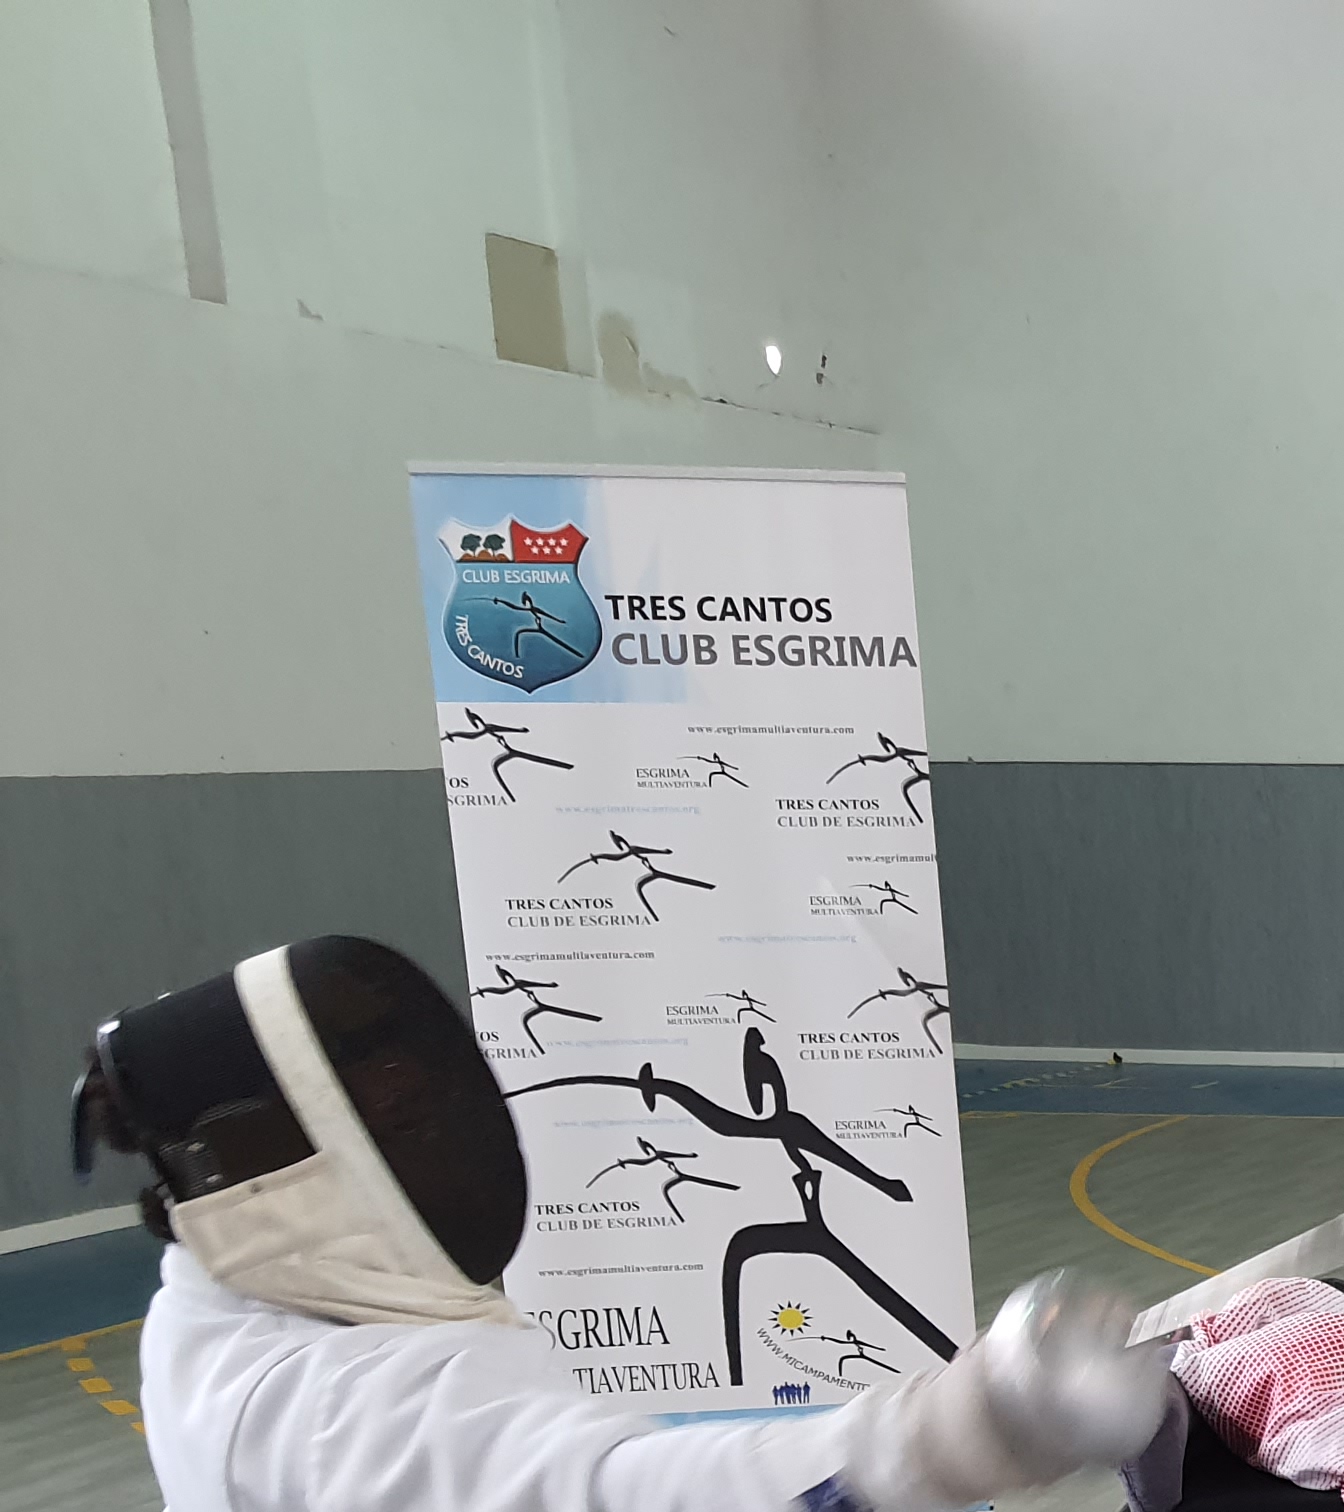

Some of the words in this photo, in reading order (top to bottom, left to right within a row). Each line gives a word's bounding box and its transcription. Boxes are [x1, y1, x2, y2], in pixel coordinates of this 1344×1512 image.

[462, 569, 500, 583] CLUB
[504, 569, 571, 584] ESGRIMA
[604, 594, 686, 621] TRES
[696, 596, 833, 624] CANTOS
[455, 615, 473, 647] TRES
[467, 645, 525, 679] CANTOS
[611, 632, 718, 666] CLUB
[732, 635, 918, 668] ESGRIMA
[636, 768, 690, 779] ESGRIMA
[637, 781, 708, 789] MULTIAVENTURA
[775, 799, 815, 811] TRES
[818, 799, 880, 811] CANTOS
[777, 816, 818, 828] CLUB
[822, 816, 843, 827] DE
[847, 816, 916, 828] ESGRIMA
[504, 899, 546, 911] TRES
[549, 898, 614, 910] CANTOS
[809, 896, 862, 906] ESGRIMA
[507, 916, 550, 928] CLUB
[554, 915, 574, 927] DE
[579, 914, 651, 926] ESGRIMA
[666, 1006, 719, 1016] ESGRIMA
[798, 1033, 836, 1044] TRES
[839, 1032, 900, 1043] CANTOS
[799, 1049, 840, 1060] CLUB
[844, 1049, 864, 1060] DE
[867, 1048, 937, 1059] ESGRIMA
[834, 1121, 887, 1131] ESGRIMA
[534, 1203, 575, 1215] TRES
[577, 1201, 641, 1214] CANTOS
[536, 1219, 579, 1232] CLUB
[582, 1218, 603, 1230] DE
[607, 1216, 678, 1229] ESGRIMA
[523, 1305, 671, 1351] SGRIMA
[756, 1327, 872, 1391] WWW.MICAMPAMENT
